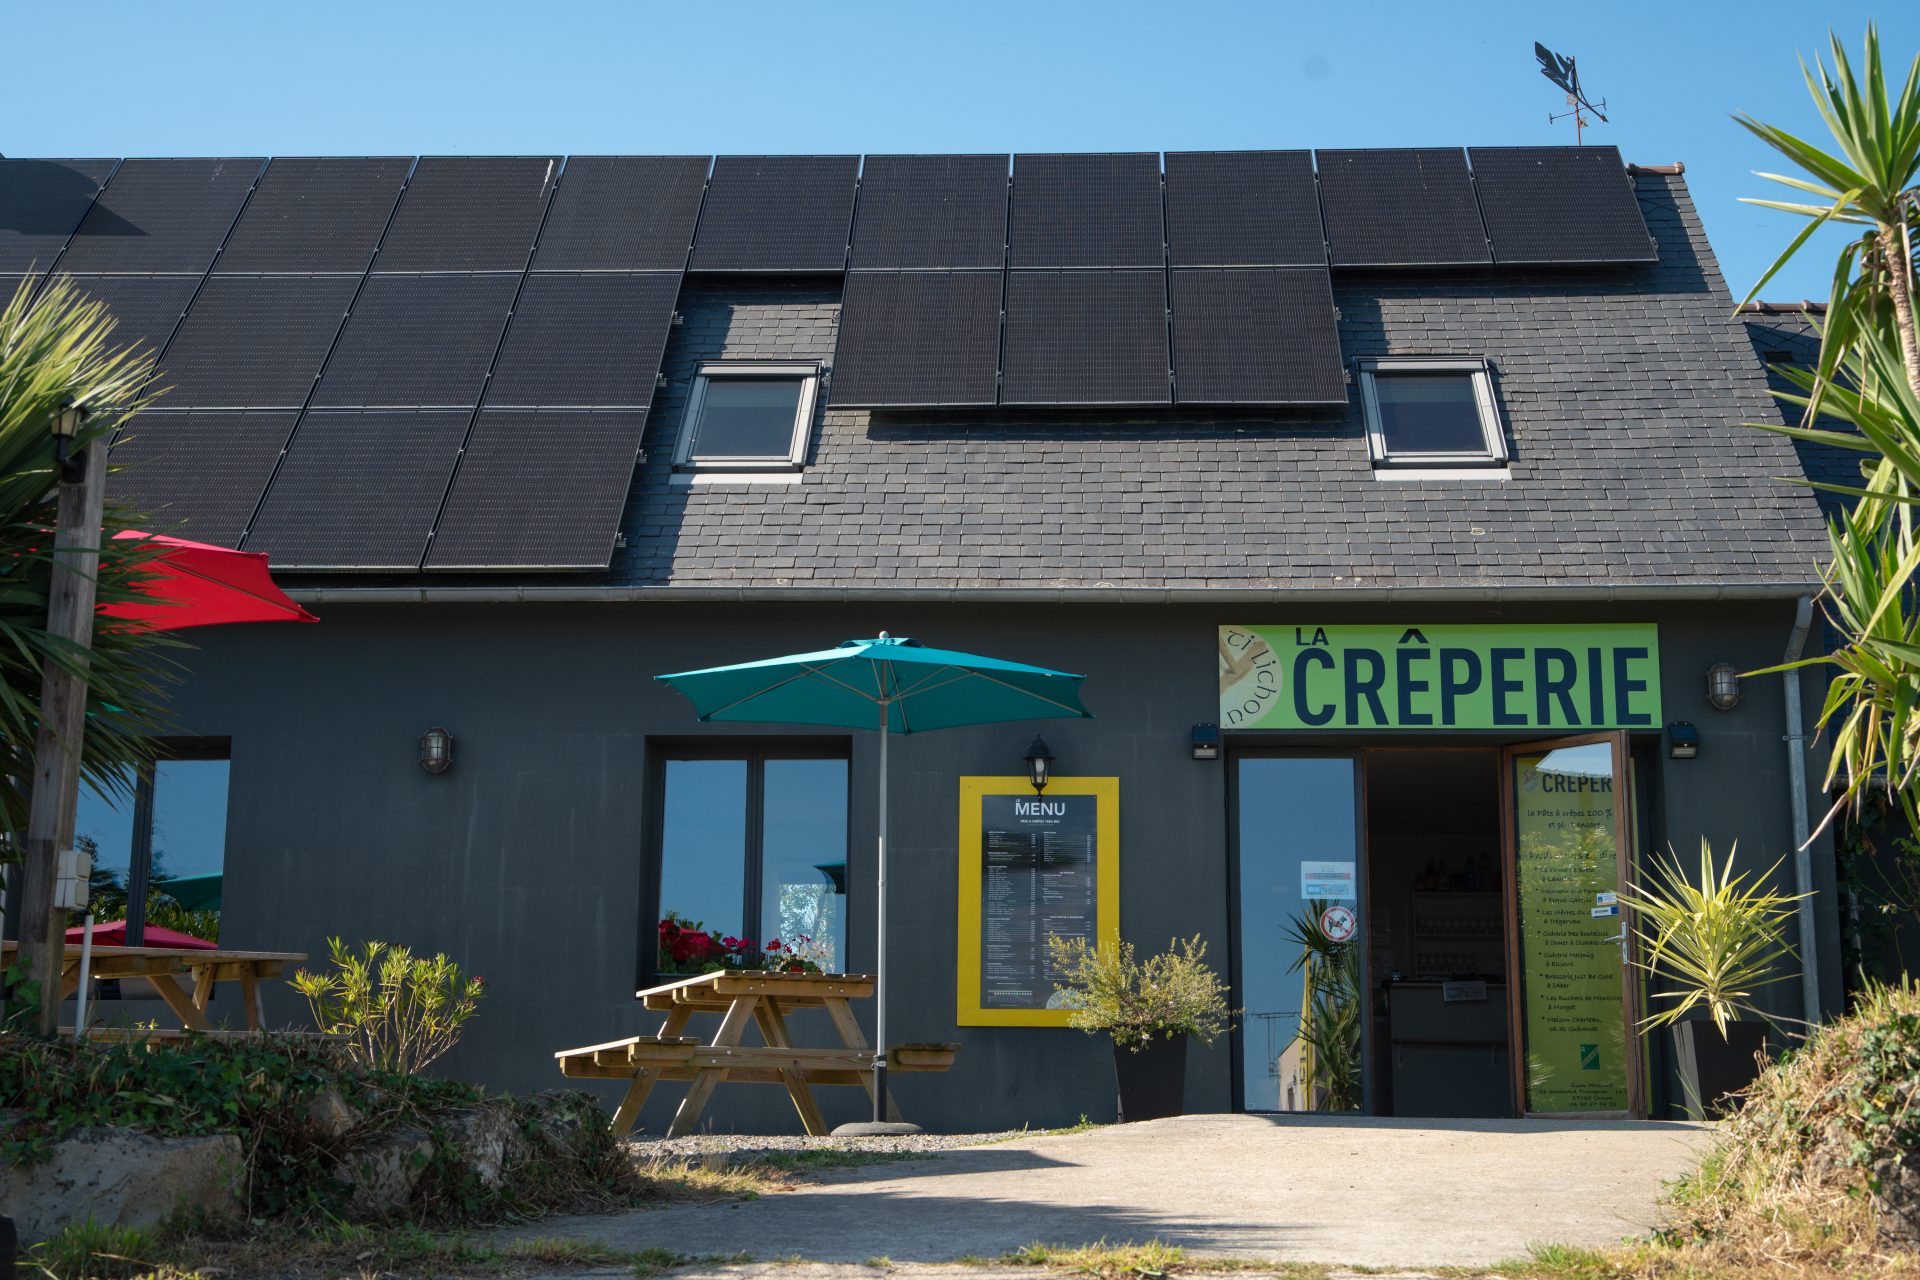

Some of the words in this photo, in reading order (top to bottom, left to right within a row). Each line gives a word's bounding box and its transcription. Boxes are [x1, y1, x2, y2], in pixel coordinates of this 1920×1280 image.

[1296, 627, 1329, 646] LA
[1227, 648, 1277, 725] Lichou
[1293, 628, 1652, 726] CRÊPERIE
[1015, 802, 1065, 816] MENU
[1587, 809, 1603, 817] 100
